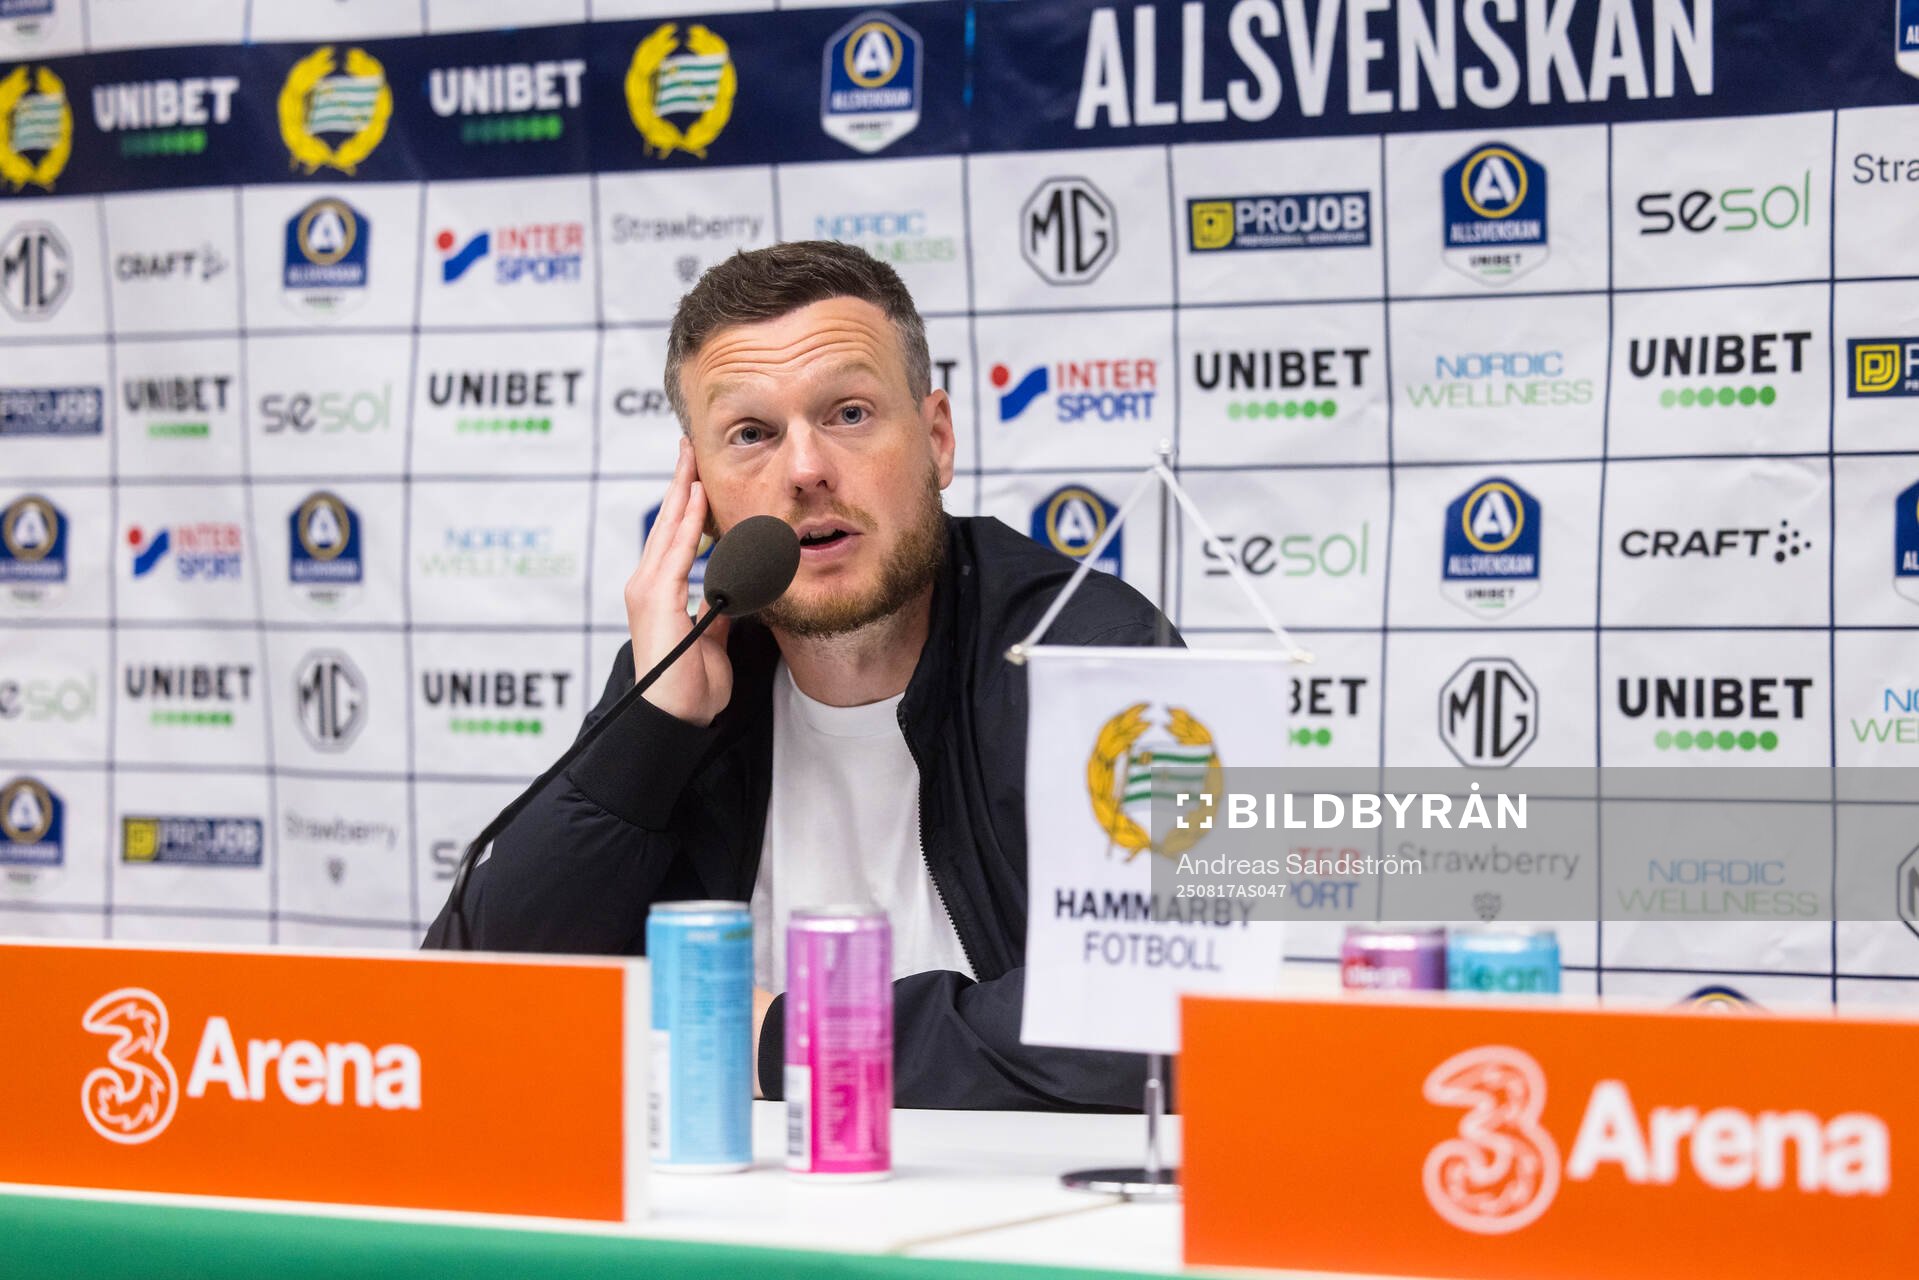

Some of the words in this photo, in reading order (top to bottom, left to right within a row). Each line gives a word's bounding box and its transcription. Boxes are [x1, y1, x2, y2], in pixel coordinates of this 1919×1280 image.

[1075, 0, 1715, 129] ALLSVENSKAN
[94, 76, 240, 131] UNIBET
[429, 61, 587, 117] UNIBET
[1235, 196, 1367, 234] PROJOB
[1636, 168, 1811, 235] sesol
[496, 222, 584, 253] INTER
[612, 213, 763, 244] Strawberry
[814, 211, 926, 237] NORDIC
[1030, 188, 1109, 276] MG
[496, 255, 582, 285] SPORT
[1056, 359, 1157, 389] INTER
[1193, 347, 1371, 391] UNIBET
[1435, 351, 1565, 380] NORDIC
[1629, 332, 1813, 378] UNIBET
[124, 375, 233, 414] UNIBET
[428, 368, 585, 407] UNIBET
[1056, 391, 1157, 423] SPORT
[1406, 380, 1594, 409] WELLNESS
[259, 383, 392, 435] sesol
[1202, 521, 1369, 578] sesol
[1620, 528, 1771, 559] CRAFT
[125, 665, 254, 700] UNIBET
[422, 670, 573, 711] UNIBET
[1618, 677, 1813, 719] UNIBET
[1449, 668, 1529, 759] MG
[1398, 841, 1580, 880] Strawberry
[1649, 858, 1787, 886] NORDIC
[1055, 888, 1257, 930] HAMMARBY
[1617, 888, 1820, 917] WELLNESS
[1083, 930, 1223, 972] FOTBOLL
[186, 1016, 422, 1110] Arena
[1565, 1079, 1891, 1196] Arena
